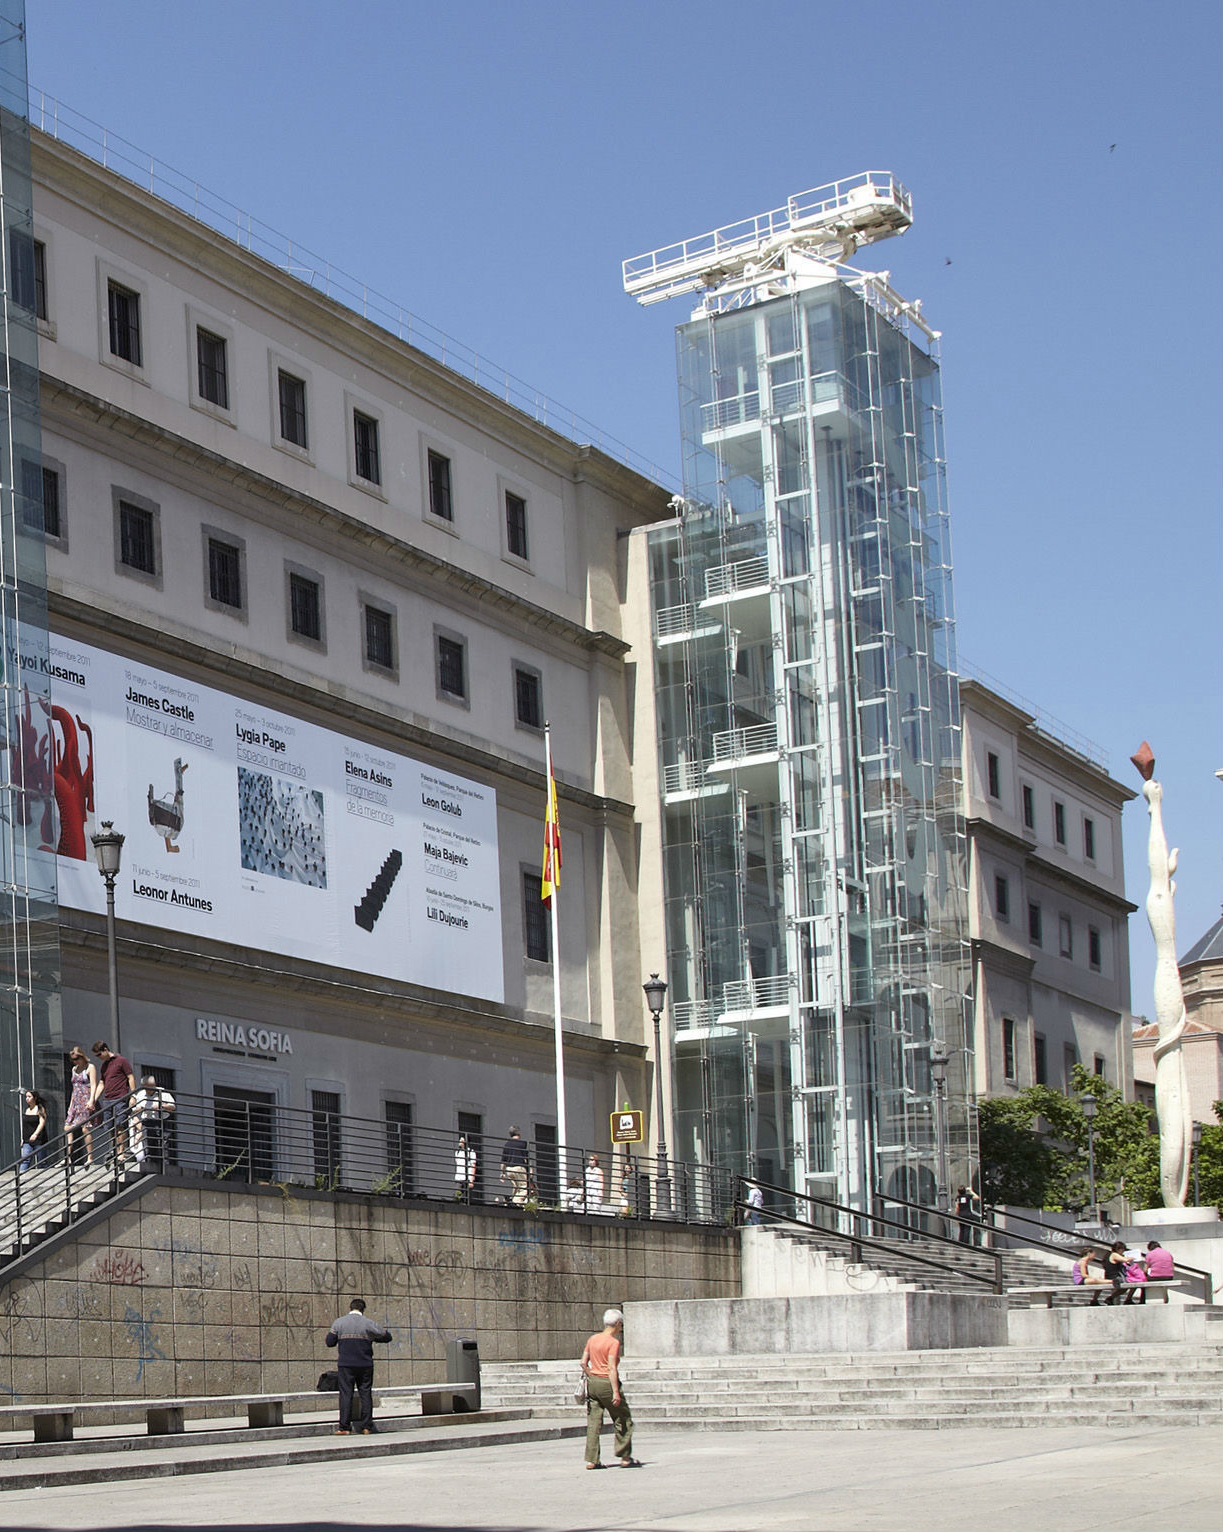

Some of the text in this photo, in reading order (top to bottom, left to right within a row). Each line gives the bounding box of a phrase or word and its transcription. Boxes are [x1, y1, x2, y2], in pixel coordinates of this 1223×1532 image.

[7, 645, 86, 686] Yayoi Kusama
[126, 686, 195, 721] James Castle
[126, 705, 214, 747] Mostrar y almacenar
[236, 723, 286, 753] Lygia Pape
[237, 742, 268, 766] Espacio
[345, 760, 393, 788] Elena Asins
[346, 778, 388, 805] Fragmentos
[421, 792, 462, 817] Leon Golub
[346, 797, 356, 812] de
[363, 805, 395, 825] memoria
[424, 842, 469, 866] Maja Bajevic
[133, 879, 213, 912] Leonor Antunes
[426, 906, 469, 929] Lili Dujourie
[196, 1018, 247, 1046] REINA
[247, 1027, 293, 1054] SOFIA
